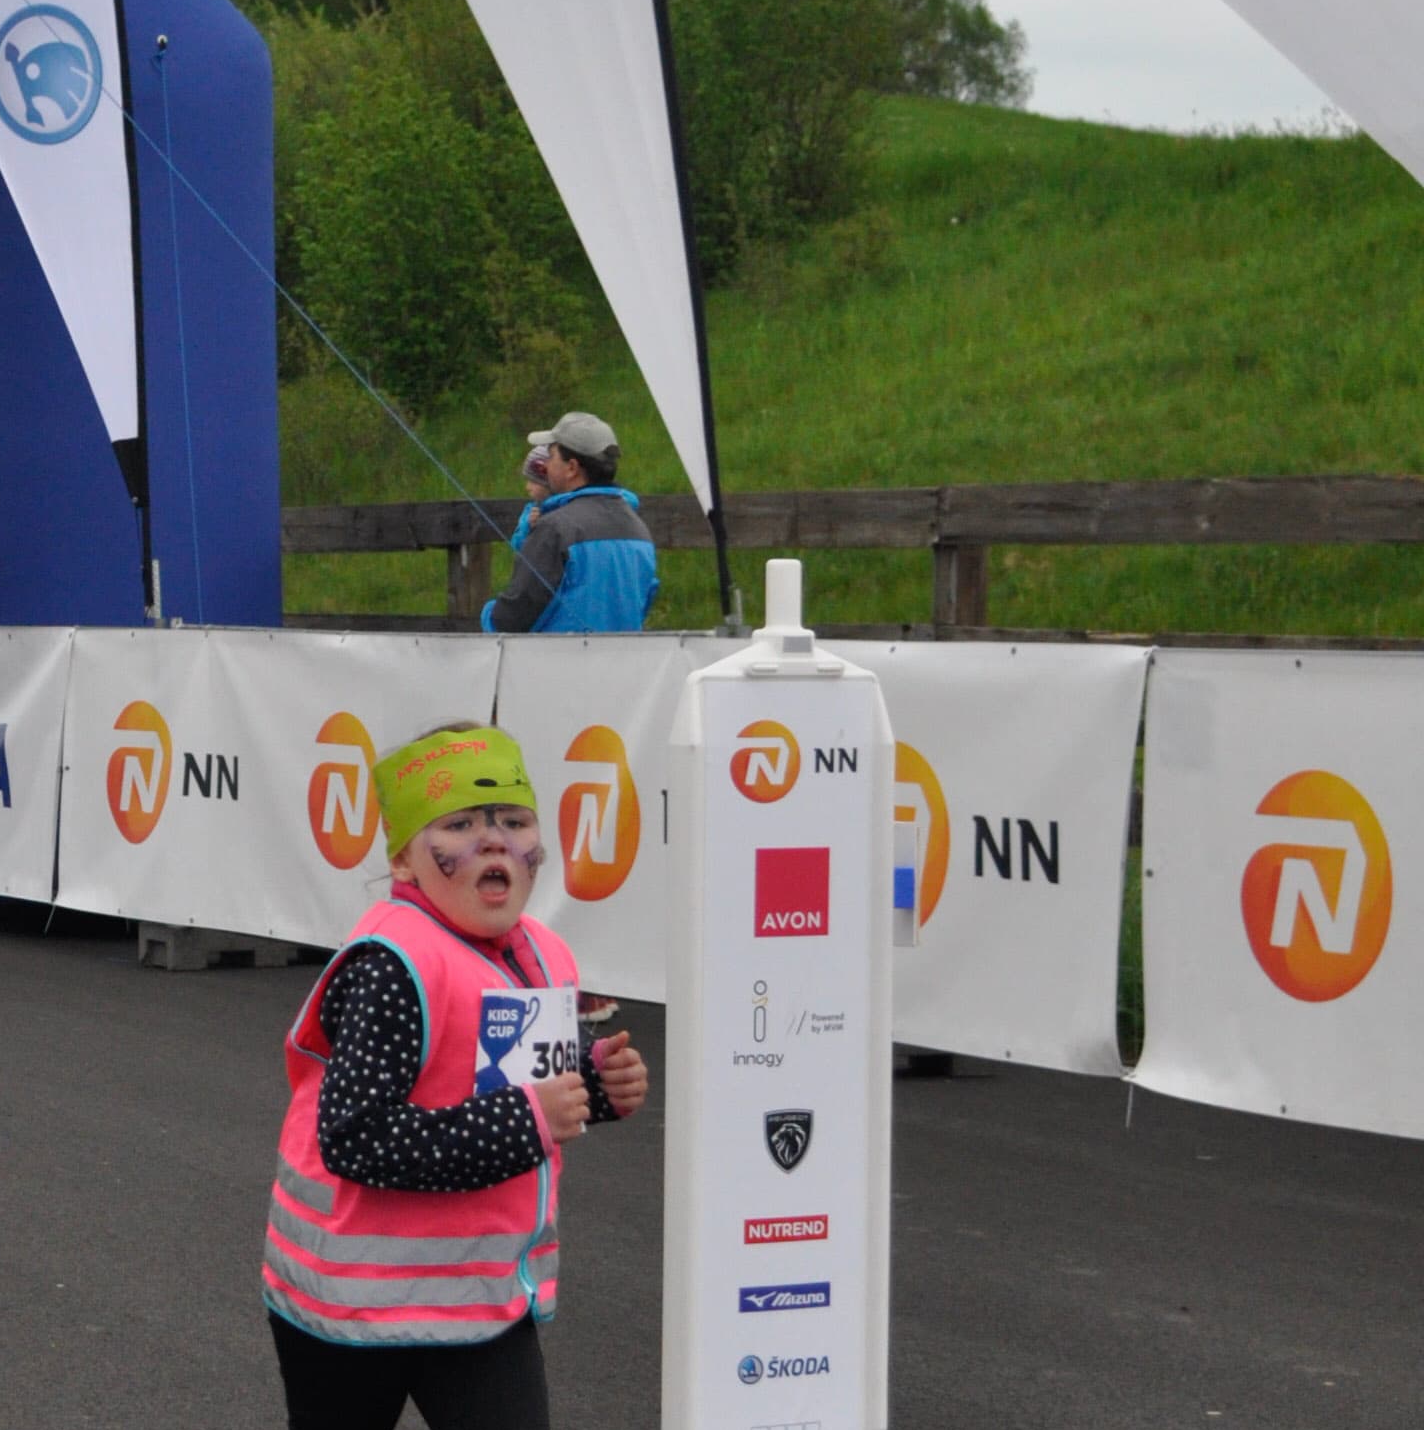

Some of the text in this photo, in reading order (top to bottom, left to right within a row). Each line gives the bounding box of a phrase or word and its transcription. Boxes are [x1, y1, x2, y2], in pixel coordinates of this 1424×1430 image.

[814, 747, 858, 774] NN
[182, 752, 239, 800] NN
[973, 815, 1059, 884] NN
[762, 912, 821, 929] AVON
[487, 1009, 519, 1021] KIDS
[487, 1025, 515, 1037] CUP
[733, 1051, 784, 1067] innogy
[749, 1221, 825, 1239] NUTREND
[767, 1355, 830, 1378] ŠKODA
